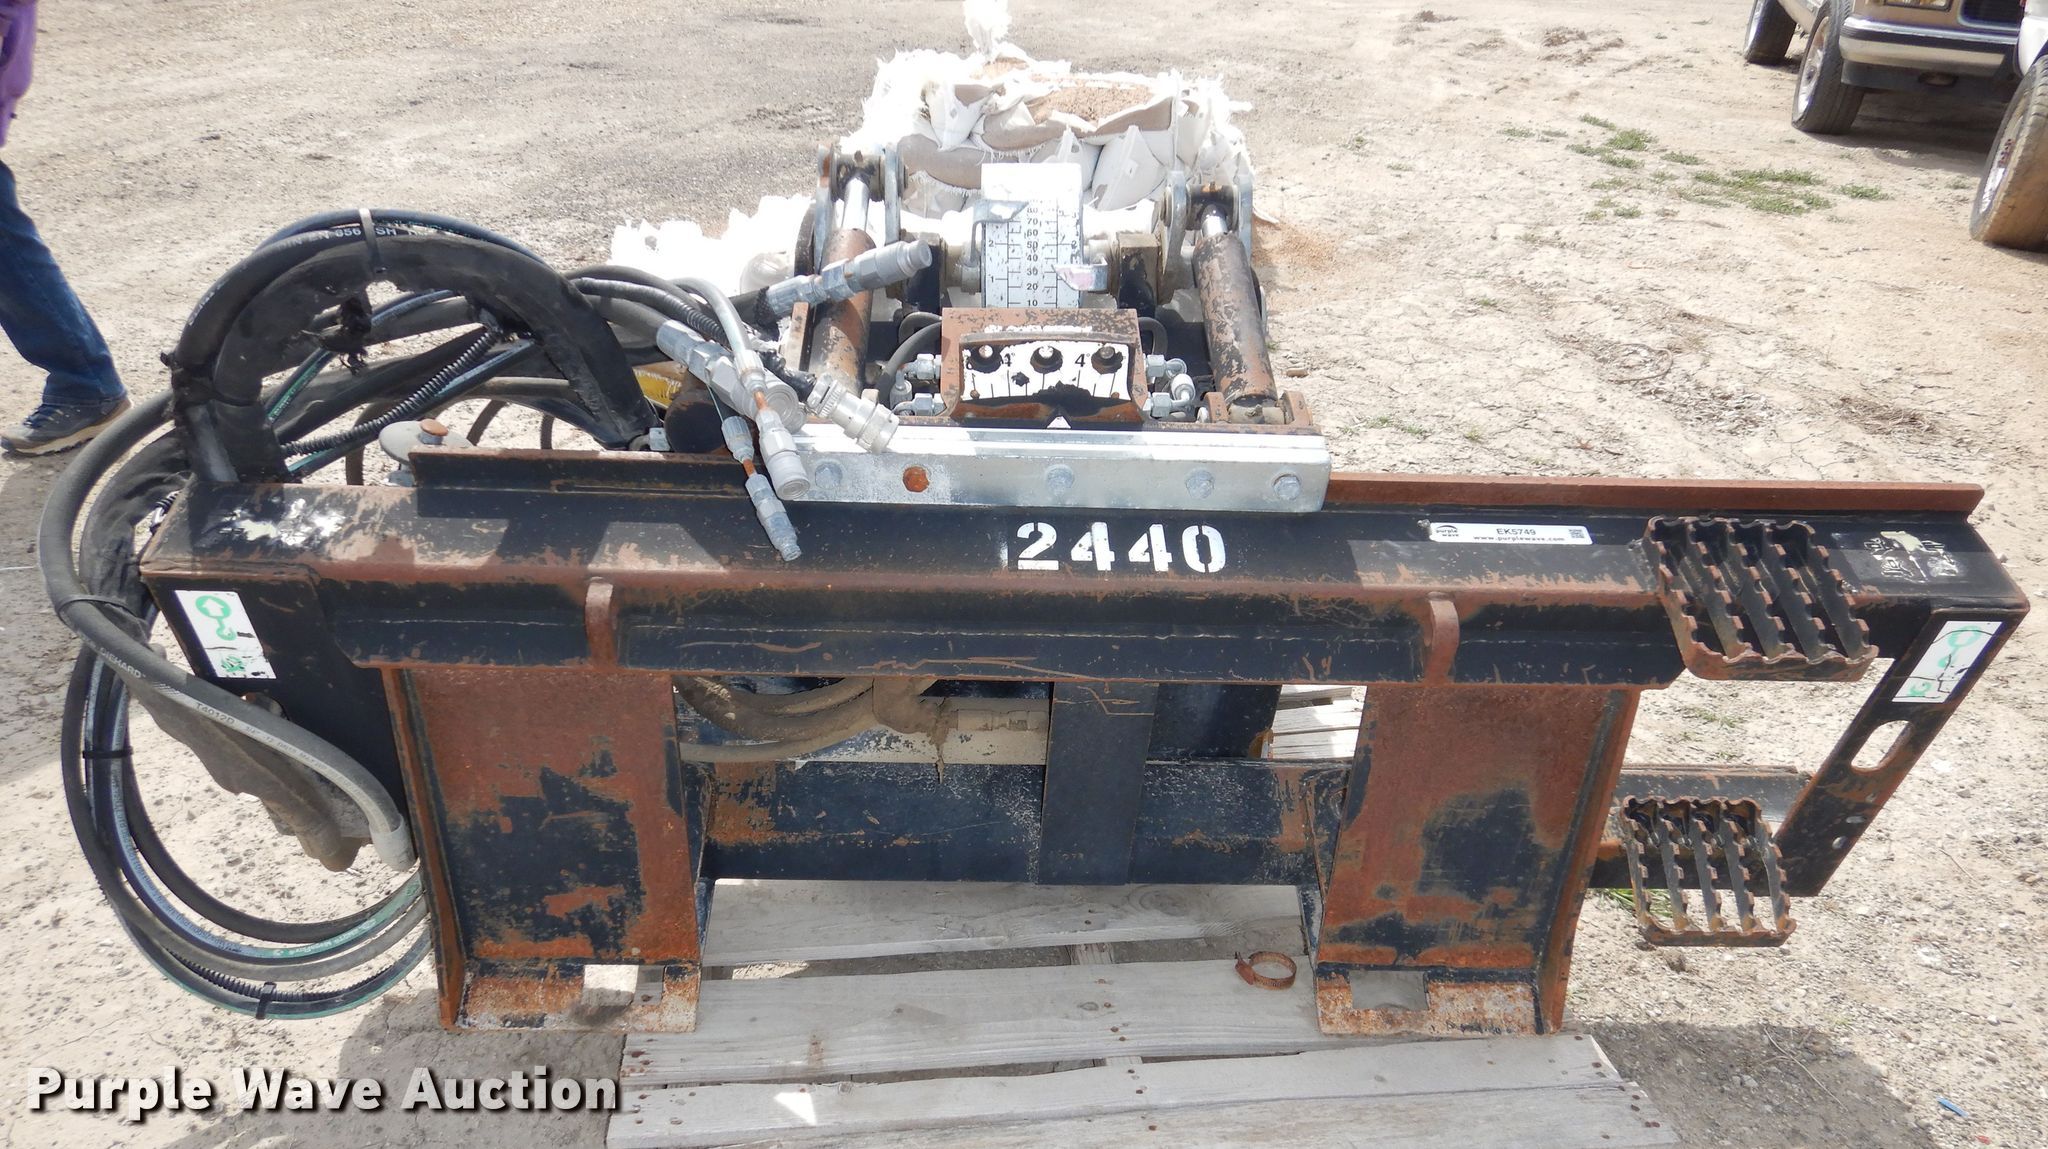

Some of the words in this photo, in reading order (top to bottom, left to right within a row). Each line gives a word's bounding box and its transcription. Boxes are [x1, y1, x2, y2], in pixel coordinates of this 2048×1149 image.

[1026, 217, 1039, 226] 70
[1026, 229, 1039, 238] 60
[988, 239, 995, 248] 2
[1026, 241, 1039, 250] 50
[1026, 253, 1039, 262] 40
[1026, 268, 1039, 276] 30
[1026, 283, 1039, 291] 20
[1027, 299, 1038, 307] 10
[1016, 521, 1227, 573] 2440
